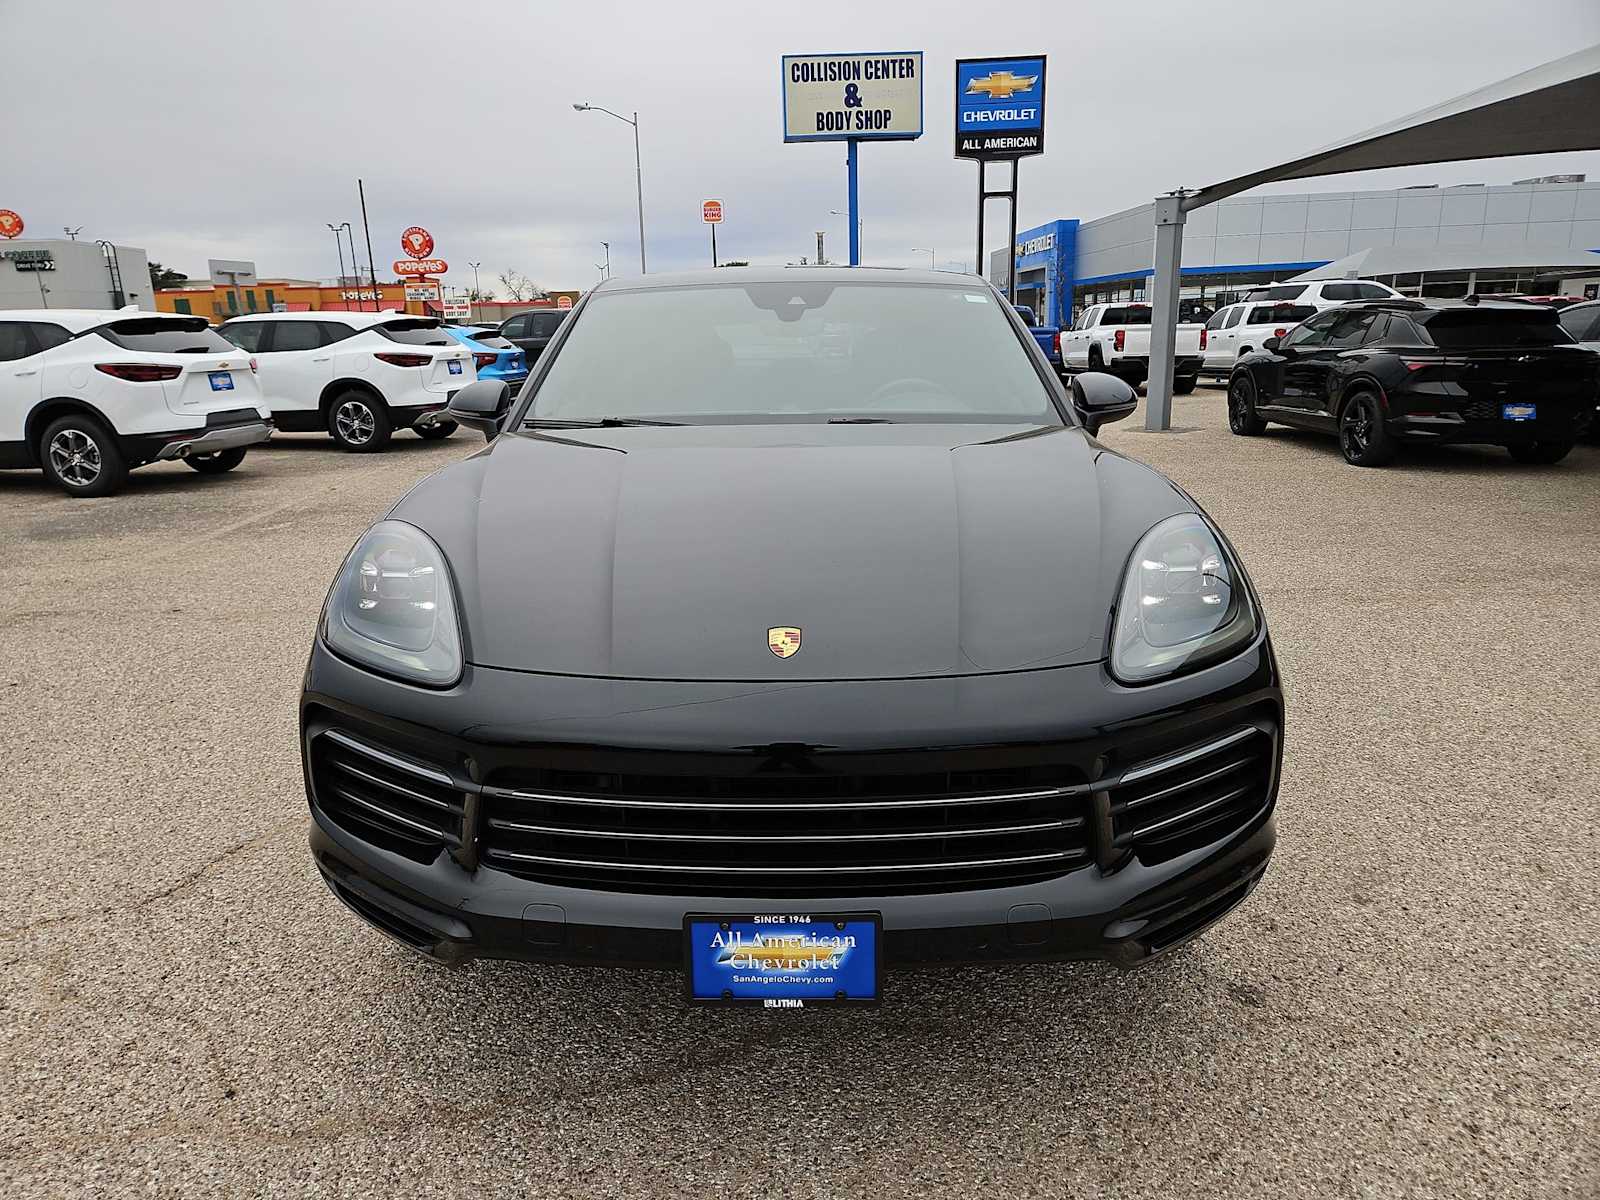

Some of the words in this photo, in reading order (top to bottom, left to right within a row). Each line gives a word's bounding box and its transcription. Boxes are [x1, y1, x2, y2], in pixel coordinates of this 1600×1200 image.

[791, 61, 861, 83] COLLISION
[864, 58, 915, 81] CENTER
[844, 83, 863, 108] &
[816, 111, 855, 132] BODY
[855, 109, 892, 130] SHOP
[963, 108, 1037, 123] CHEVROLET
[962, 138, 982, 150] ALL
[984, 137, 1038, 149] AMERICAN
[1025, 233, 1057, 256] CHEVROLET
[754, 915, 786, 924] SINCE
[789, 915, 811, 924] 1946
[710, 931, 742, 948] All
[751, 931, 857, 948] American
[730, 954, 841, 970] Chevrolet
[733, 975, 834, 985] SanAngeloChevy.com
[772, 999, 804, 1008] LITHIA
